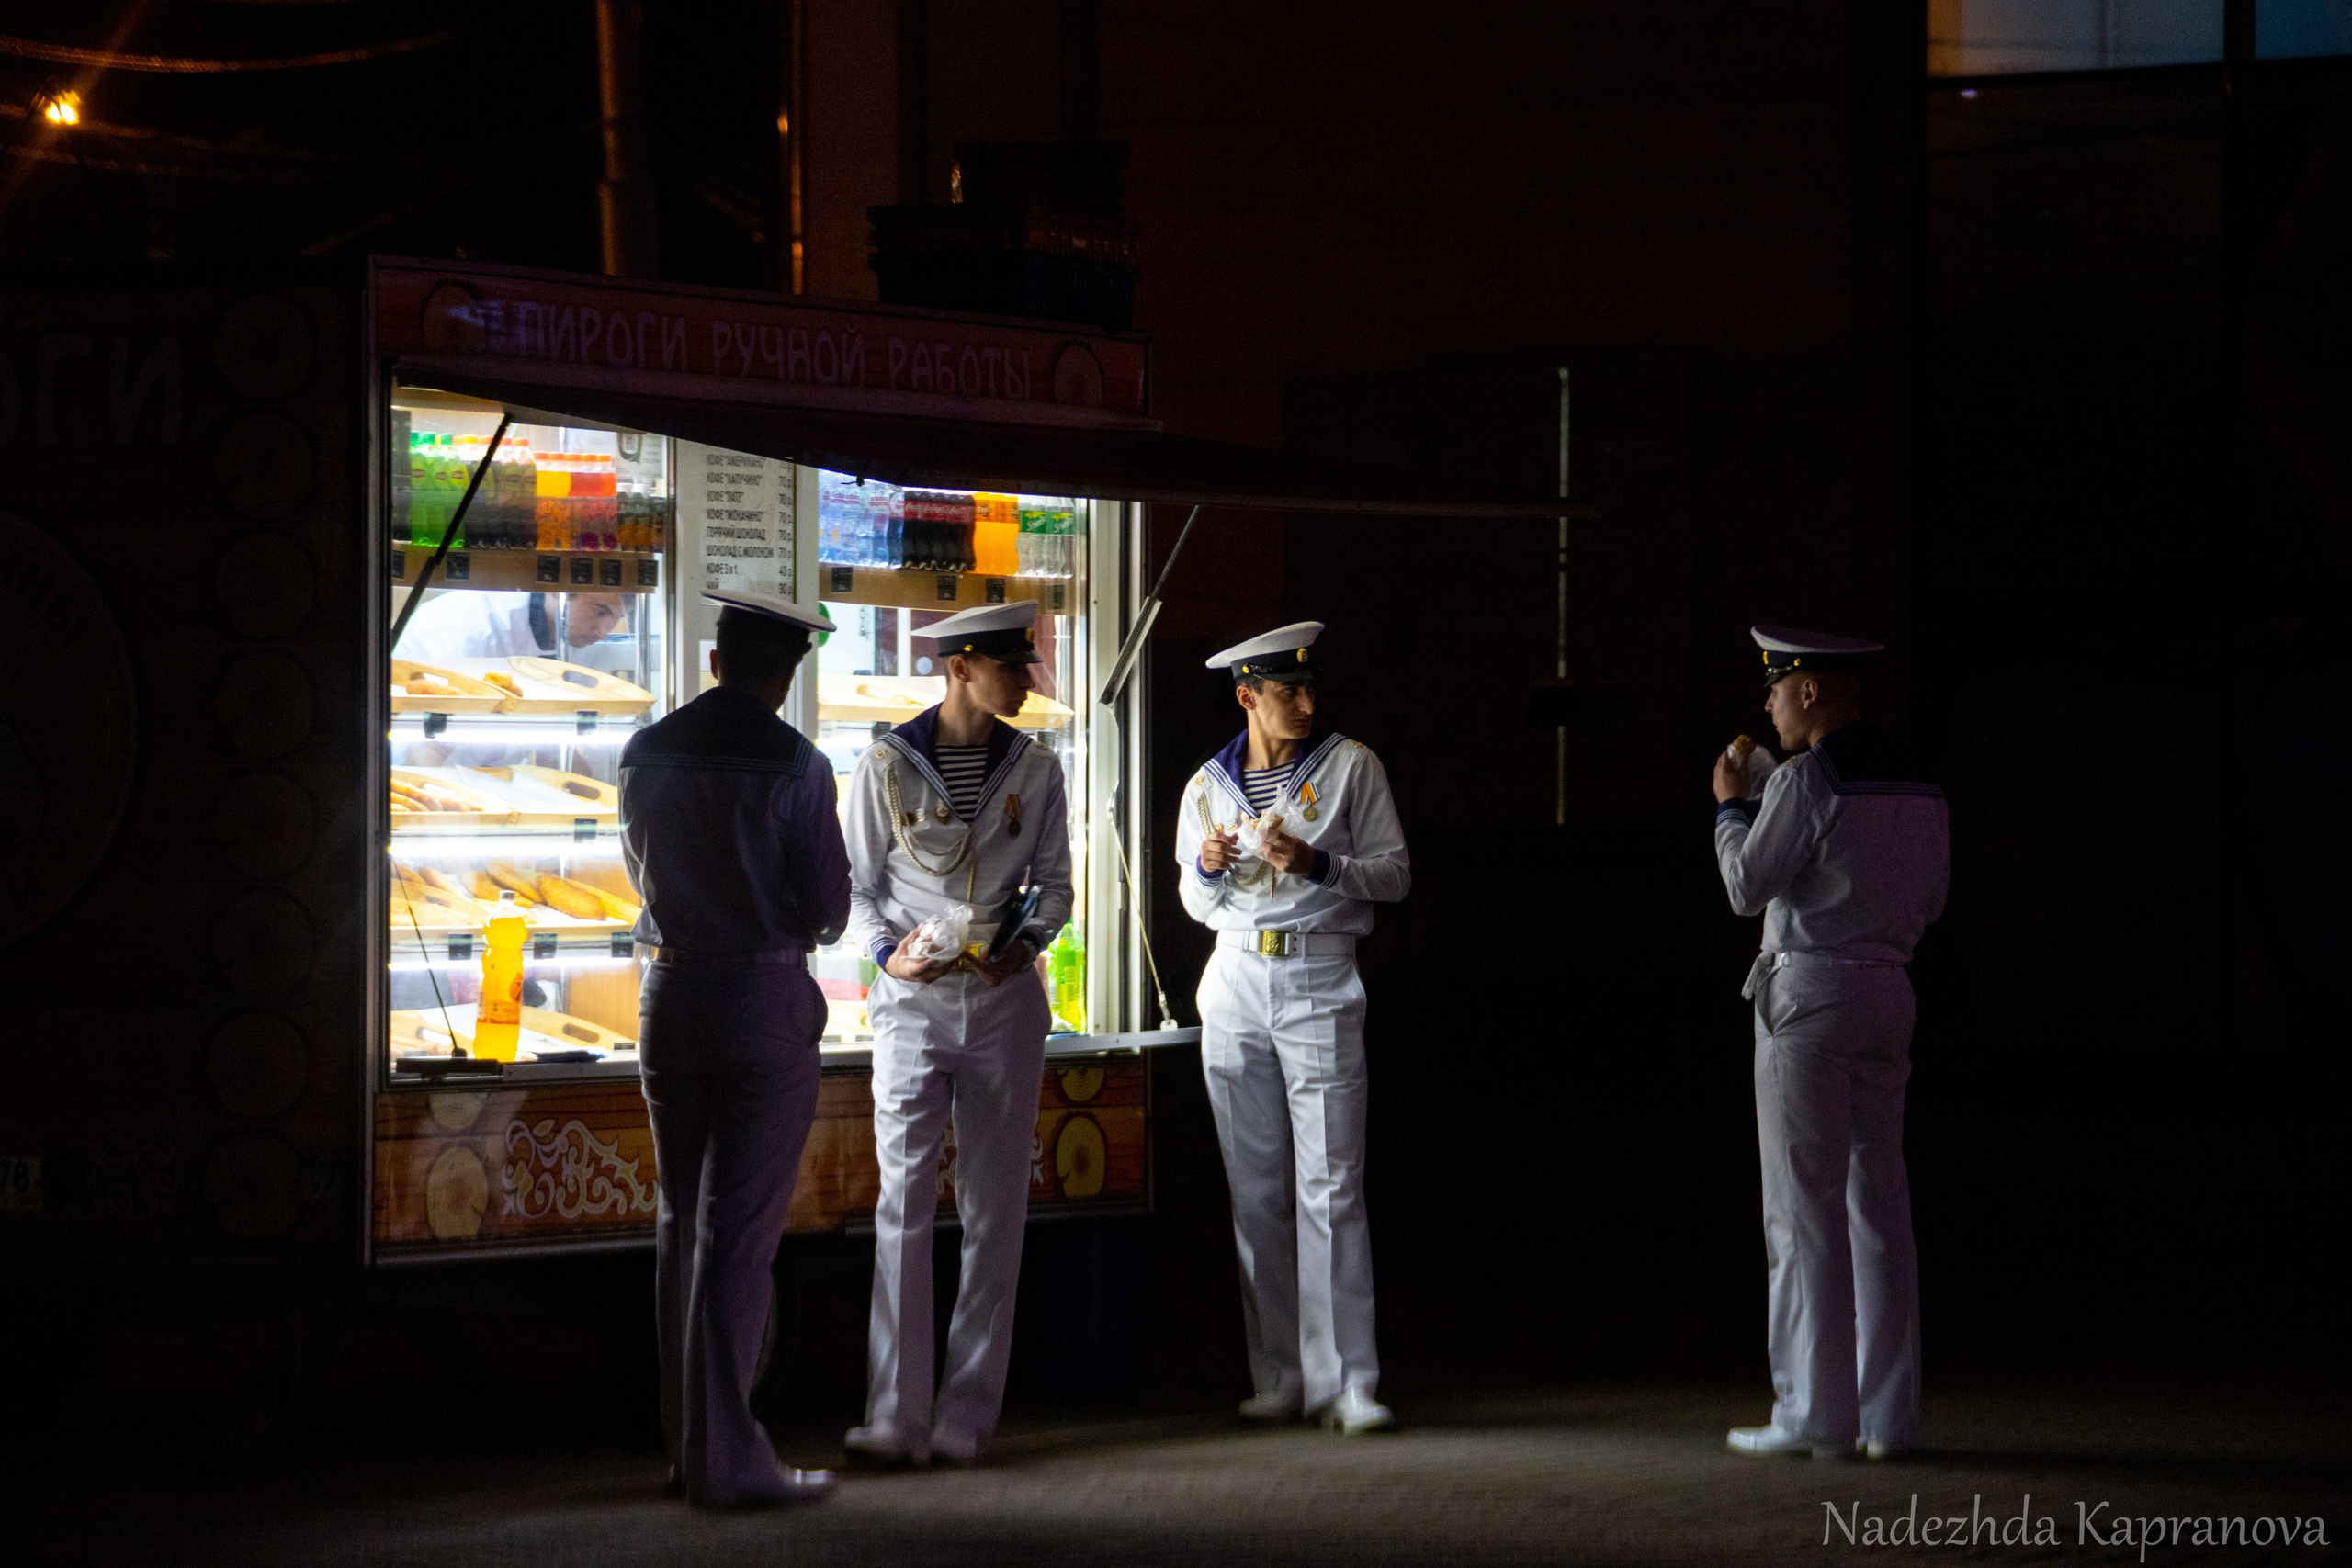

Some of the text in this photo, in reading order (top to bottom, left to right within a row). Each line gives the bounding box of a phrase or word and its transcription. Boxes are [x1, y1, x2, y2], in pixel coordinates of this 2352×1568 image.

[518, 304, 1031, 400] ПИРОГИ РУЧНОЙ РАБОТЫ
